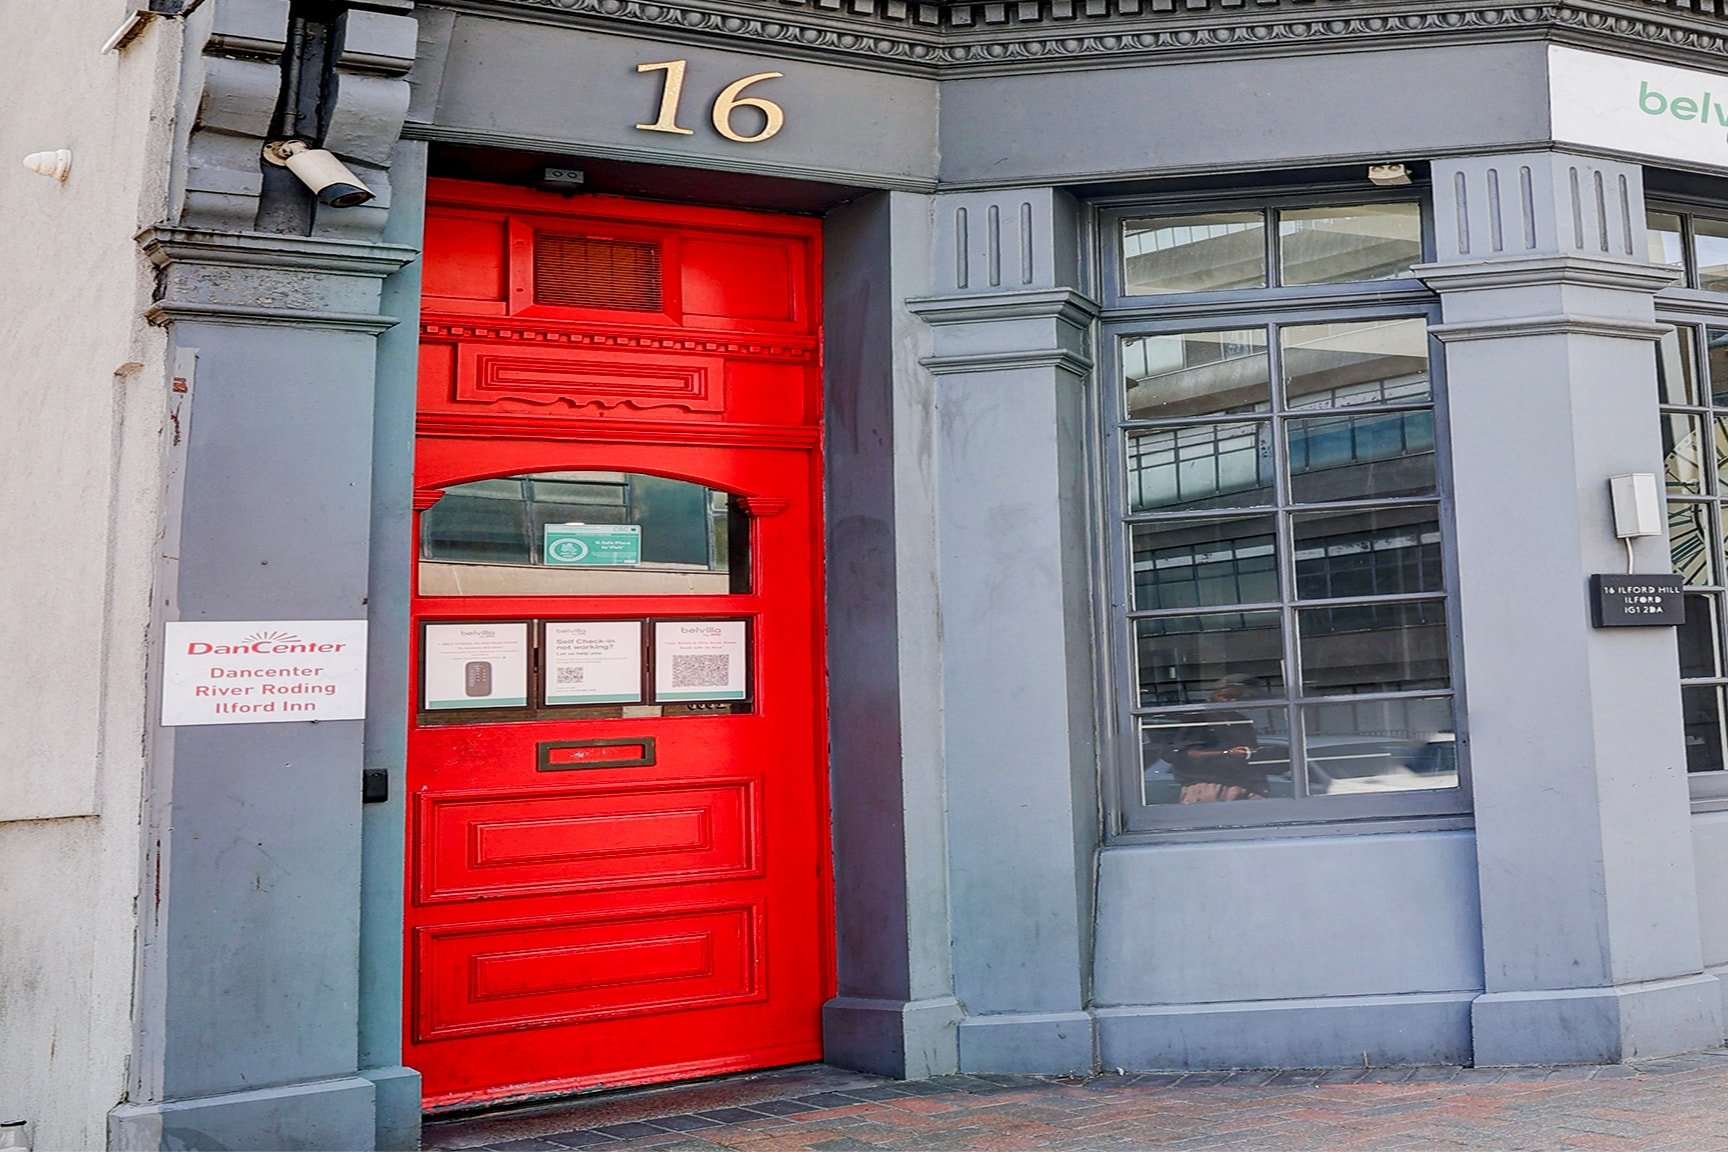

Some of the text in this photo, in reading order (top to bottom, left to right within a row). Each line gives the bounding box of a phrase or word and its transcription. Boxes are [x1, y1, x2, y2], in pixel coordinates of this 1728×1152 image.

[635, 59, 784, 143] 16
[1604, 586, 1680, 594] 16 ILFORD HILL
[1624, 596, 1662, 604] ILFORD
[1624, 606, 1640, 614] IG1
[187, 641, 346, 656] DanCenter
[210, 666, 324, 679] Dancenter
[195, 683, 336, 696] River Roding
[215, 701, 316, 714] Ilford Inn
